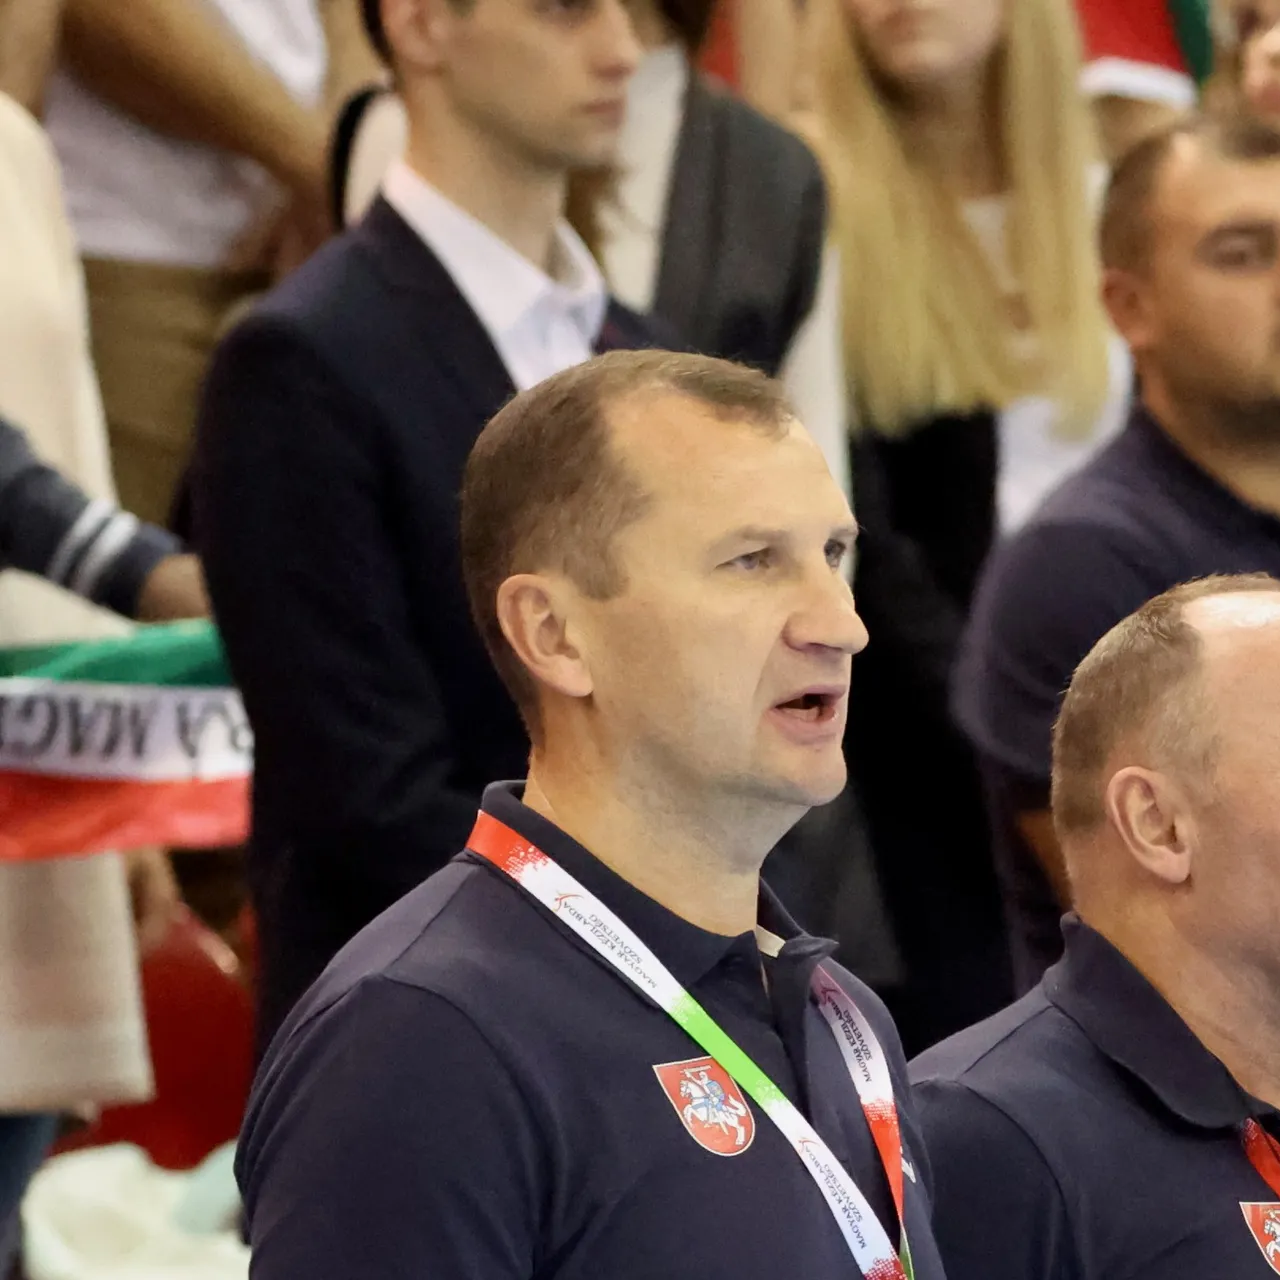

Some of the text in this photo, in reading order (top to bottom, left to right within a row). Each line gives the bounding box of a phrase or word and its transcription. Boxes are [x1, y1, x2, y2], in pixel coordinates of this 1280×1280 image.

[562, 901, 657, 989] MAGYAR KÉZILABDA
[588, 913, 643, 964] SZÖVETSÉG
[827, 996, 872, 1083] MAGYAR KÉZILABDA
[844, 1009, 872, 1061] SZÖVETSÉG
[804, 1147, 867, 1249] MAGYAR KÉZILABDA
[822, 1164, 864, 1223] SZÖVETSÉG
